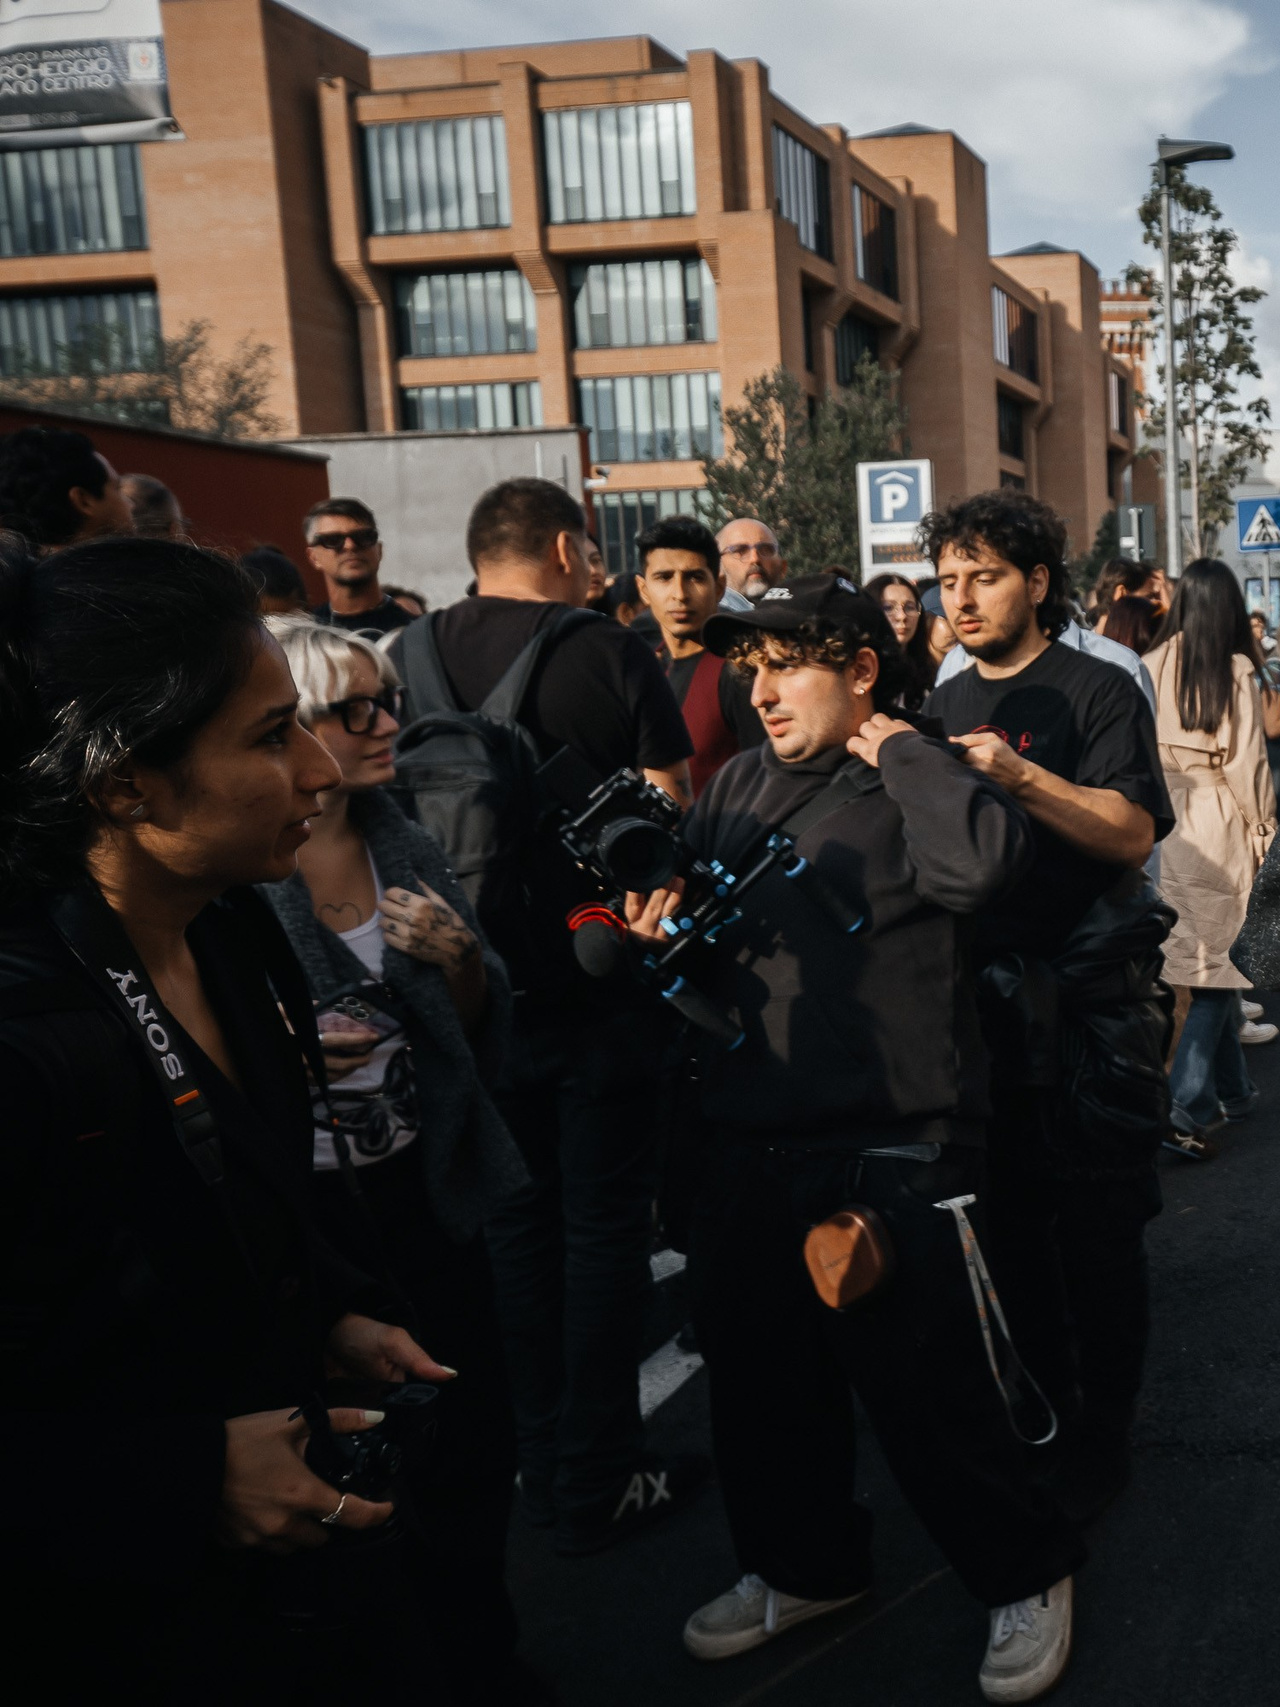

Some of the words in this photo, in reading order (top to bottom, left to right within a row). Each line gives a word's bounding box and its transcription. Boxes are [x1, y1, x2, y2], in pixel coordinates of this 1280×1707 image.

[41, 73, 114, 93] CENTRO
[881, 483, 909, 521] P
[106, 967, 184, 1080] SONY
